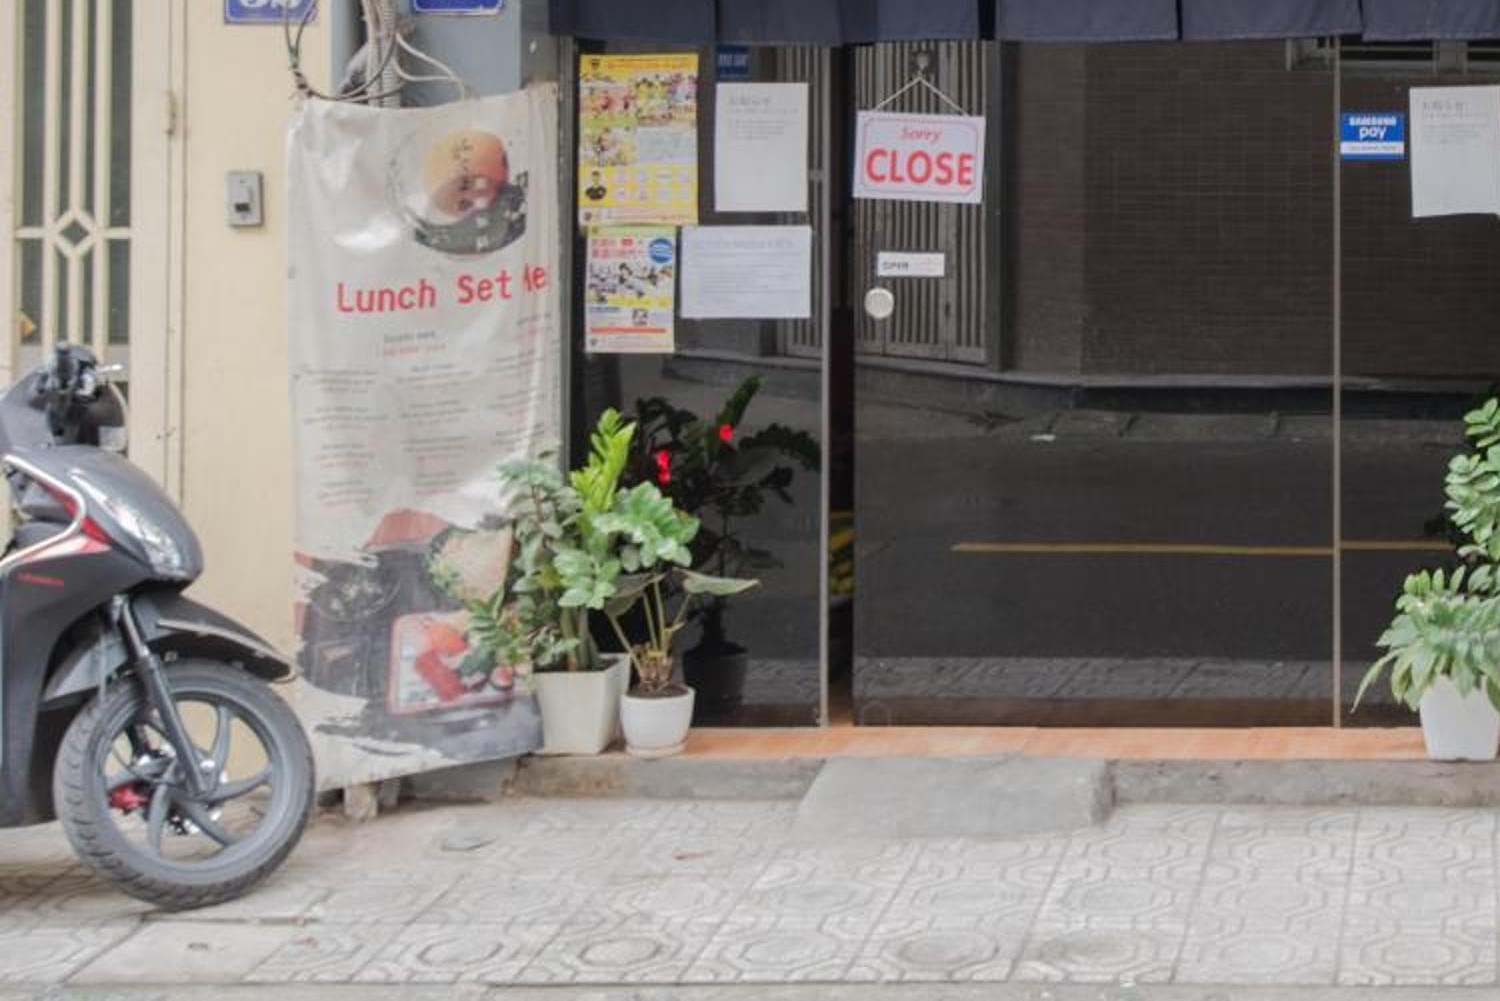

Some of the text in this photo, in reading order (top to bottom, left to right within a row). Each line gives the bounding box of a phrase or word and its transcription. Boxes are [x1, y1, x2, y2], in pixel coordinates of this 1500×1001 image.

[1359, 126, 1387, 141] pay
[865, 148, 974, 186] CLOSE
[336, 279, 437, 314] Lunch
[457, 269, 513, 305] Set
